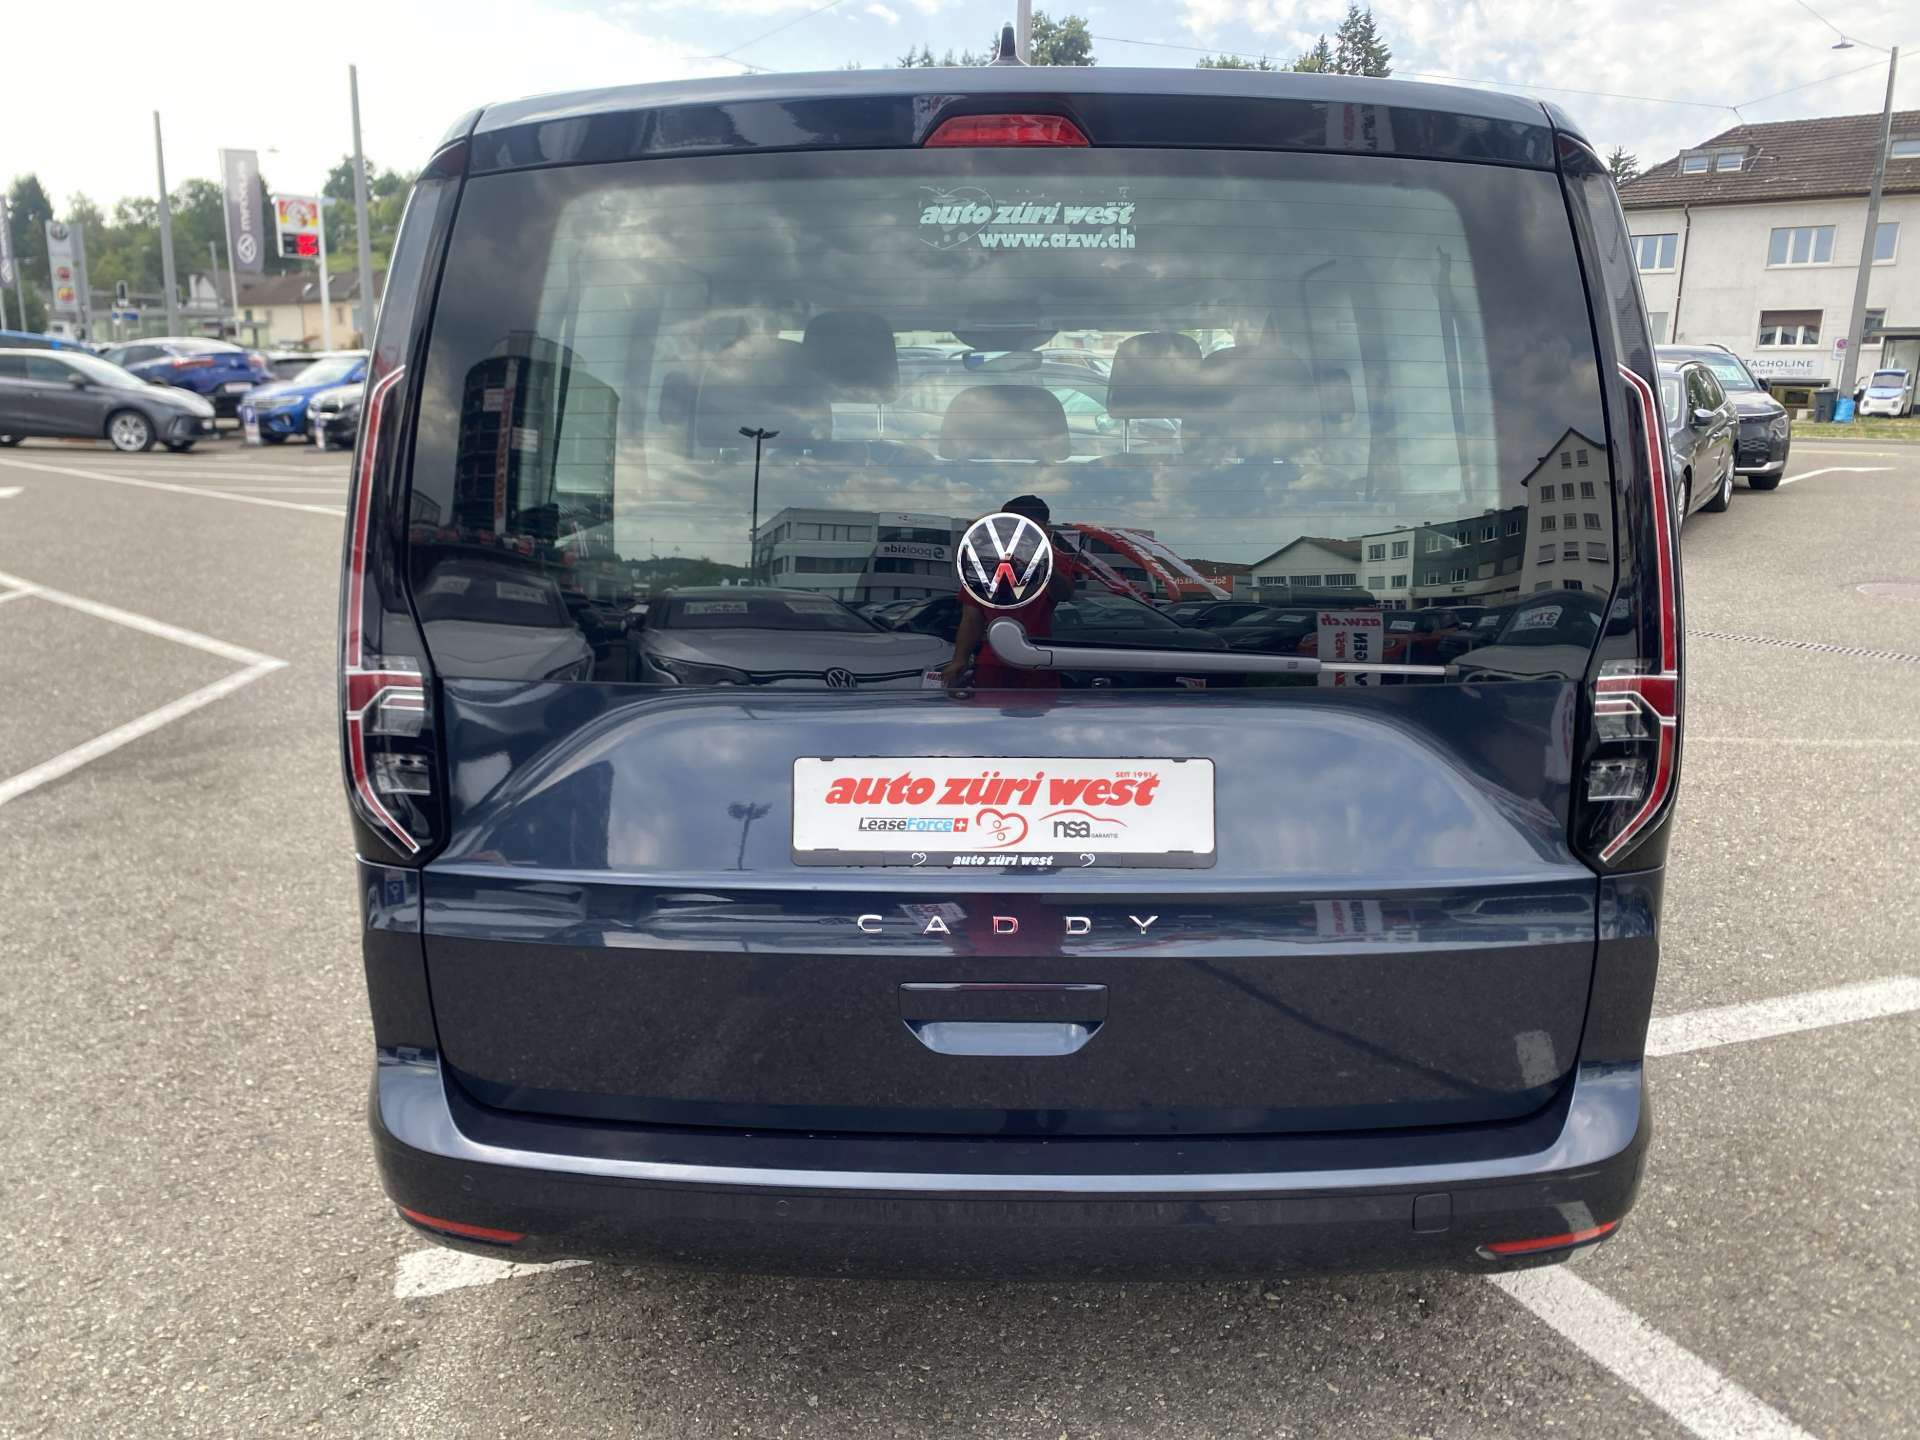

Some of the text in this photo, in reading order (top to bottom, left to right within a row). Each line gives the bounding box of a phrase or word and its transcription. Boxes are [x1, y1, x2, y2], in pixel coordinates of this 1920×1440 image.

[920, 201, 1136, 225] auto züri west
[978, 228, 1136, 249] www.azw.ch
[1744, 359, 1814, 368] TACHOLINE
[825, 771, 1161, 807] auto züri west
[858, 817, 952, 832] LeaseForce
[1053, 821, 1090, 838] nsa
[953, 854, 1054, 866] auto züri west
[857, 914, 1159, 935] CADDY
